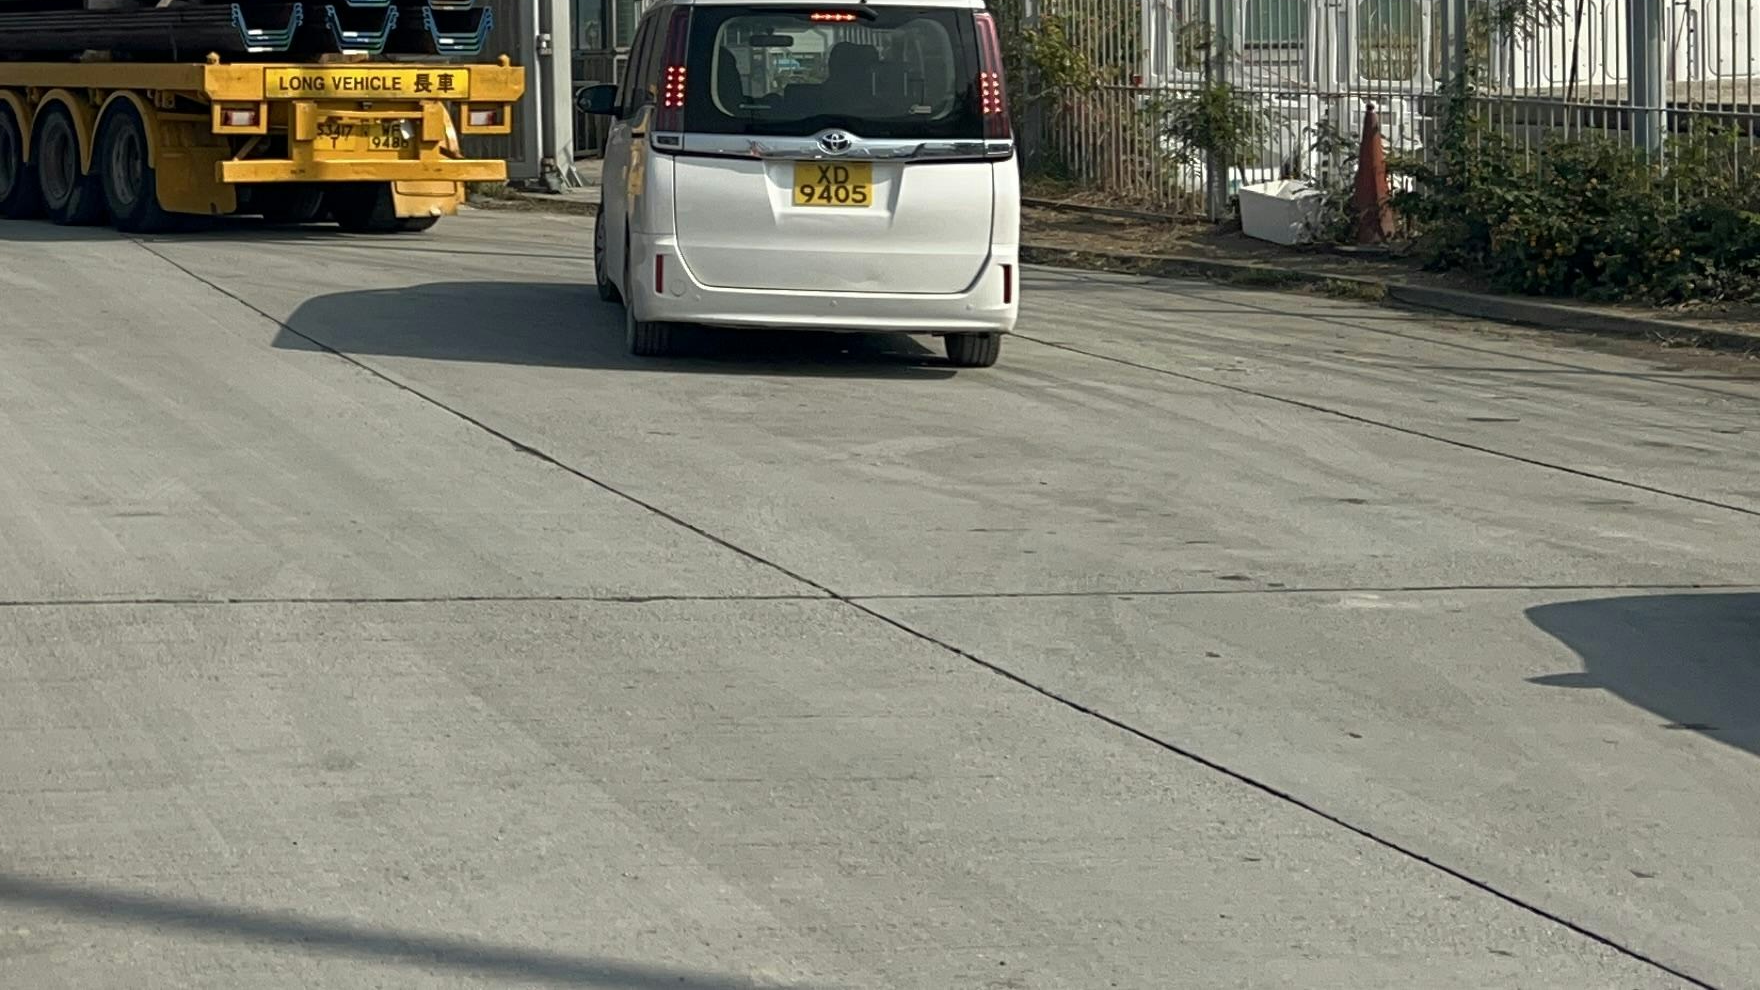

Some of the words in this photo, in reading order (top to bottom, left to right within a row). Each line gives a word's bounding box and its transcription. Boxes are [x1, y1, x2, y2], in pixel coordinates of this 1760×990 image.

[280, 76, 324, 91] LONG
[332, 75, 401, 91] VEHICLE
[414, 73, 454, 93] 長車
[817, 165, 849, 184] XD
[800, 184, 867, 203] 9405
